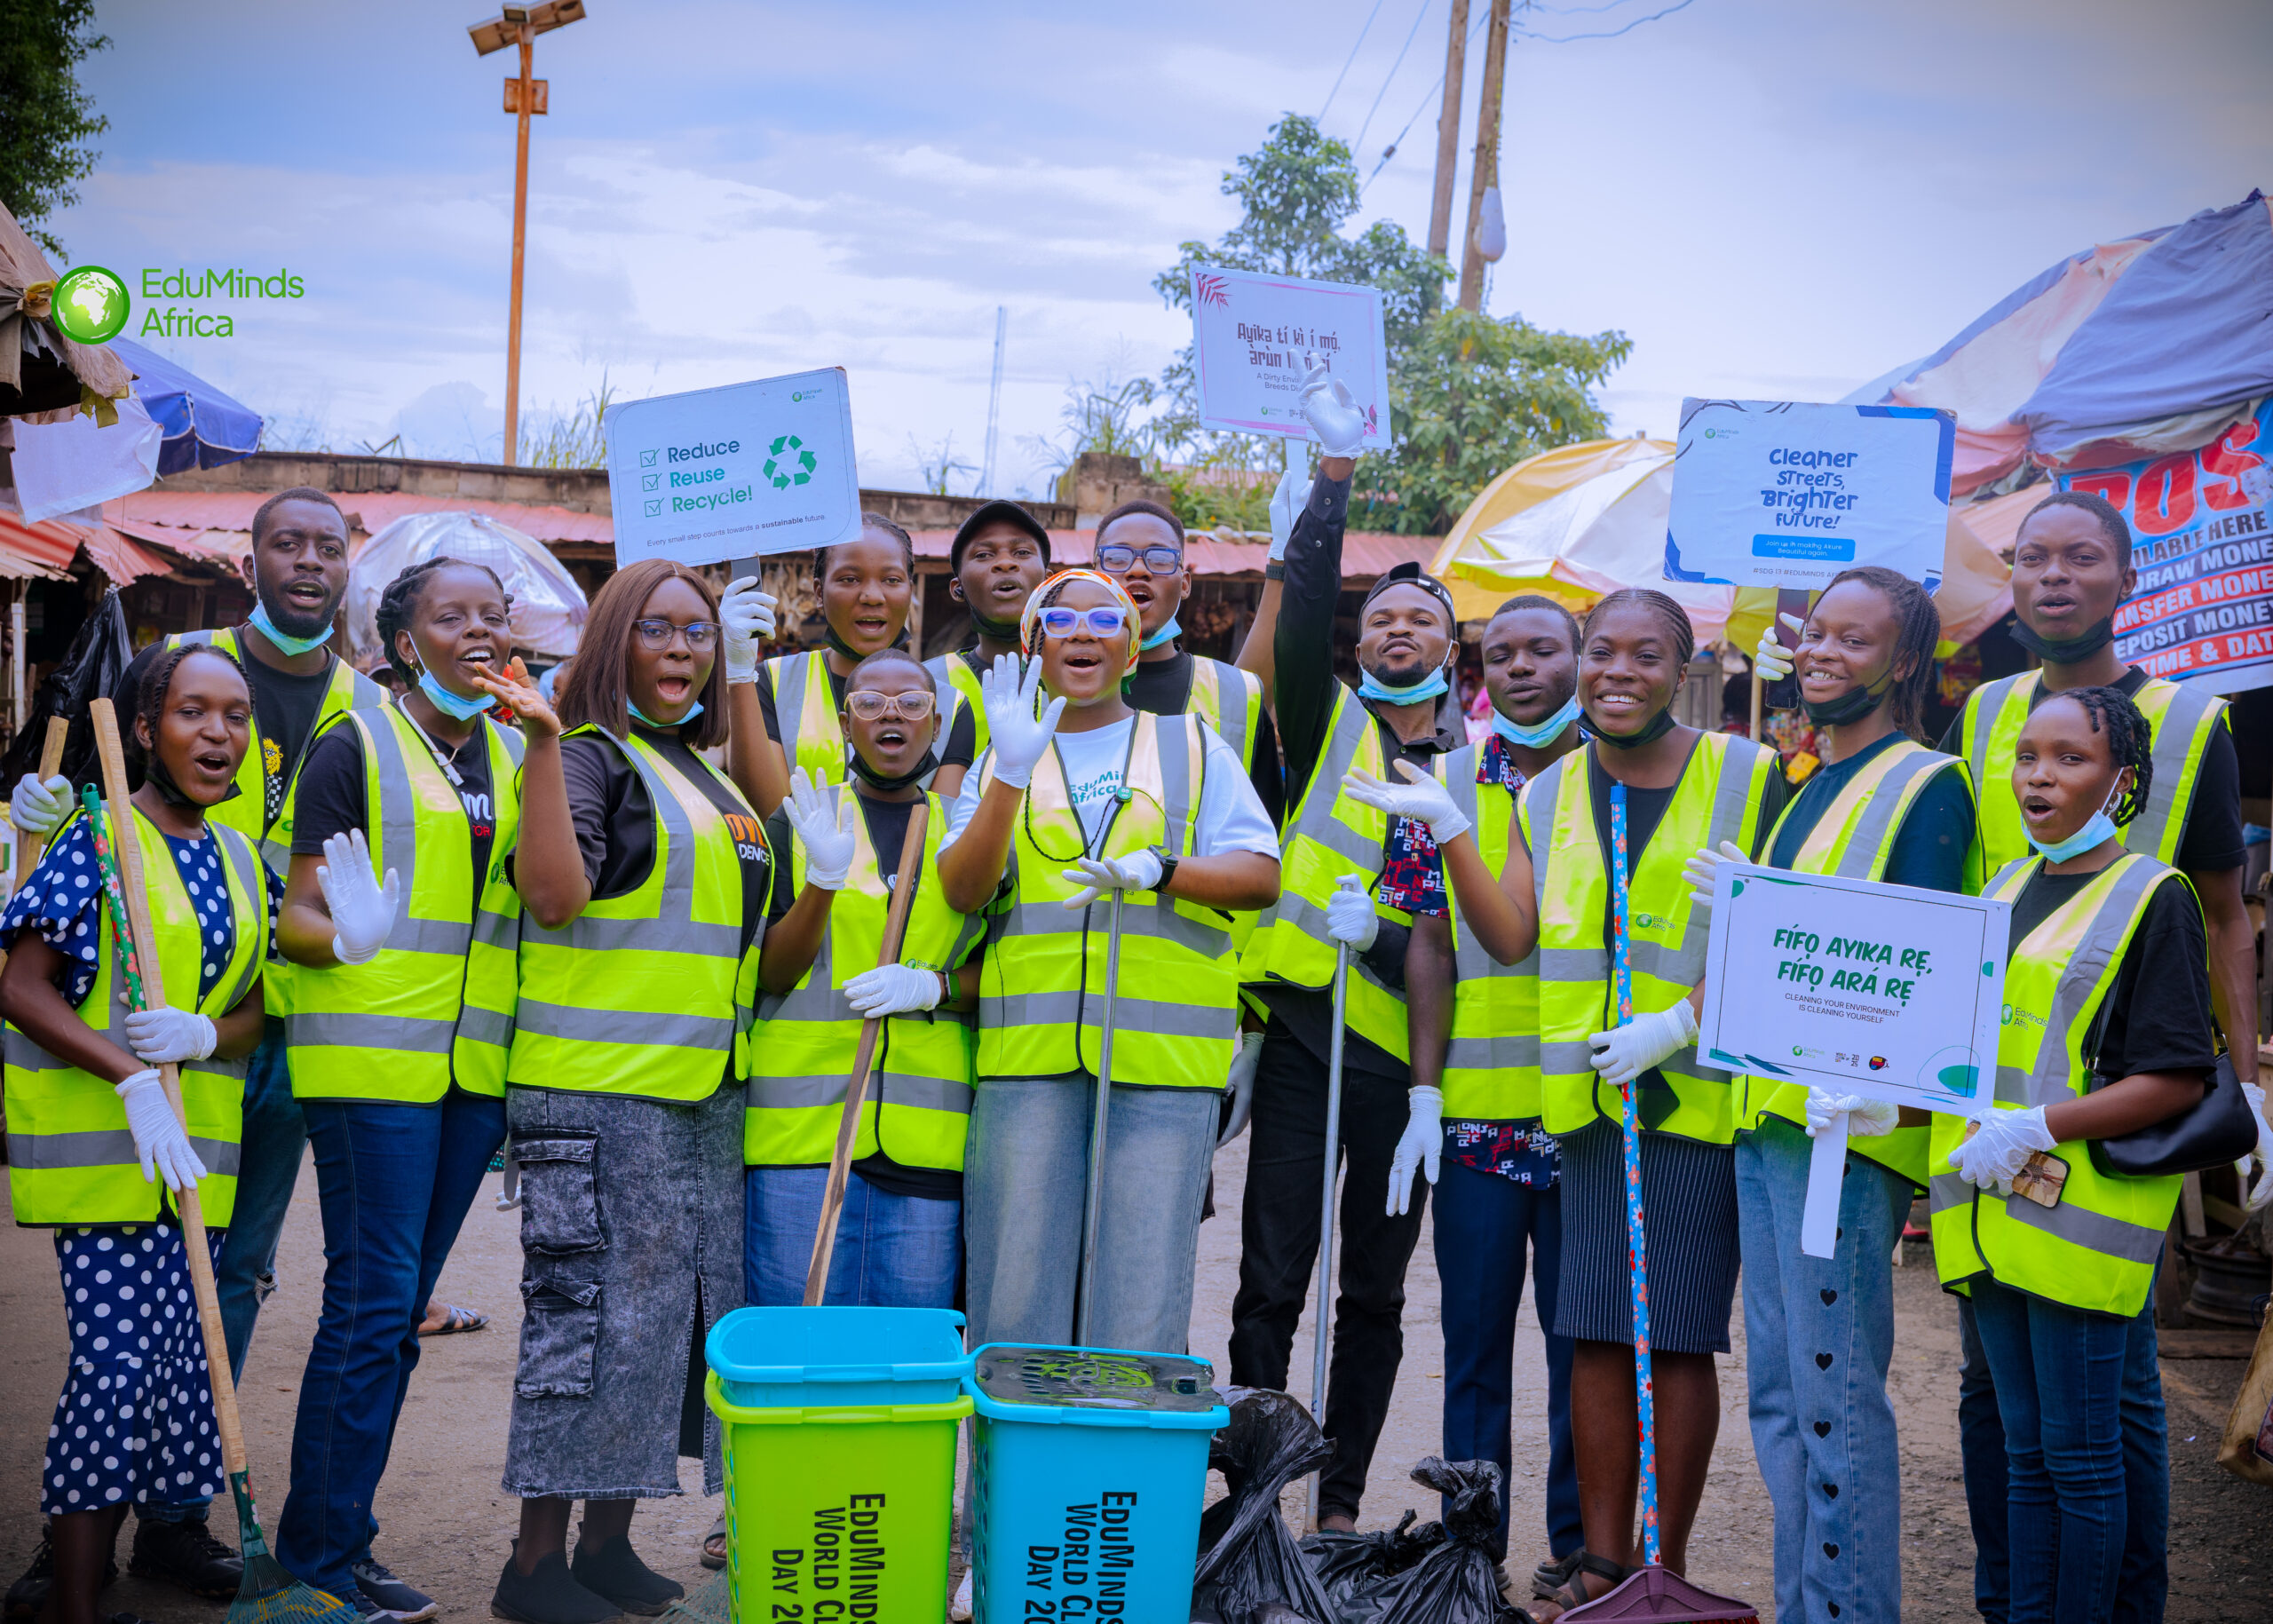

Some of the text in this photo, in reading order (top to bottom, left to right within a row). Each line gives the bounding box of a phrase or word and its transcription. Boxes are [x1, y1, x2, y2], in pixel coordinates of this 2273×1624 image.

[1238, 322, 1272, 343] Ayika
[1263, 373, 1280, 383] Dirty
[1264, 382, 1289, 391] Breeds
[668, 440, 741, 463] Reduce
[1769, 448, 1858, 470] Cleaner
[669, 467, 725, 488] Reuse
[672, 485, 753, 513] Recycle!
[646, 538, 667, 547] Every
[668, 535, 686, 544] small
[703, 529, 726, 538] counts
[726, 525, 754, 535] towards
[761, 517, 804, 529] sustainable
[2208, 511, 2269, 542] HERE
[1783, 569, 1825, 578] #EDUMINDS
[2200, 642, 2219, 662] &
[1773, 924, 1819, 960] FÍFỌ
[1826, 937, 1892, 965] AYIKA
[1778, 957, 1915, 1007] FÍFỌ ARÁ RẸ
[1785, 993, 1900, 1018] CLEANING YOUR ENVIRONMENT
[1807, 1005, 1844, 1018] CLEANING
[1846, 1011, 1884, 1024] YOURSELF
[814, 1507, 845, 1589] WORLD
[1063, 1503, 1097, 1585] WORLD
[772, 1549, 804, 1595] DAY
[1026, 1546, 1059, 1590] DAY
